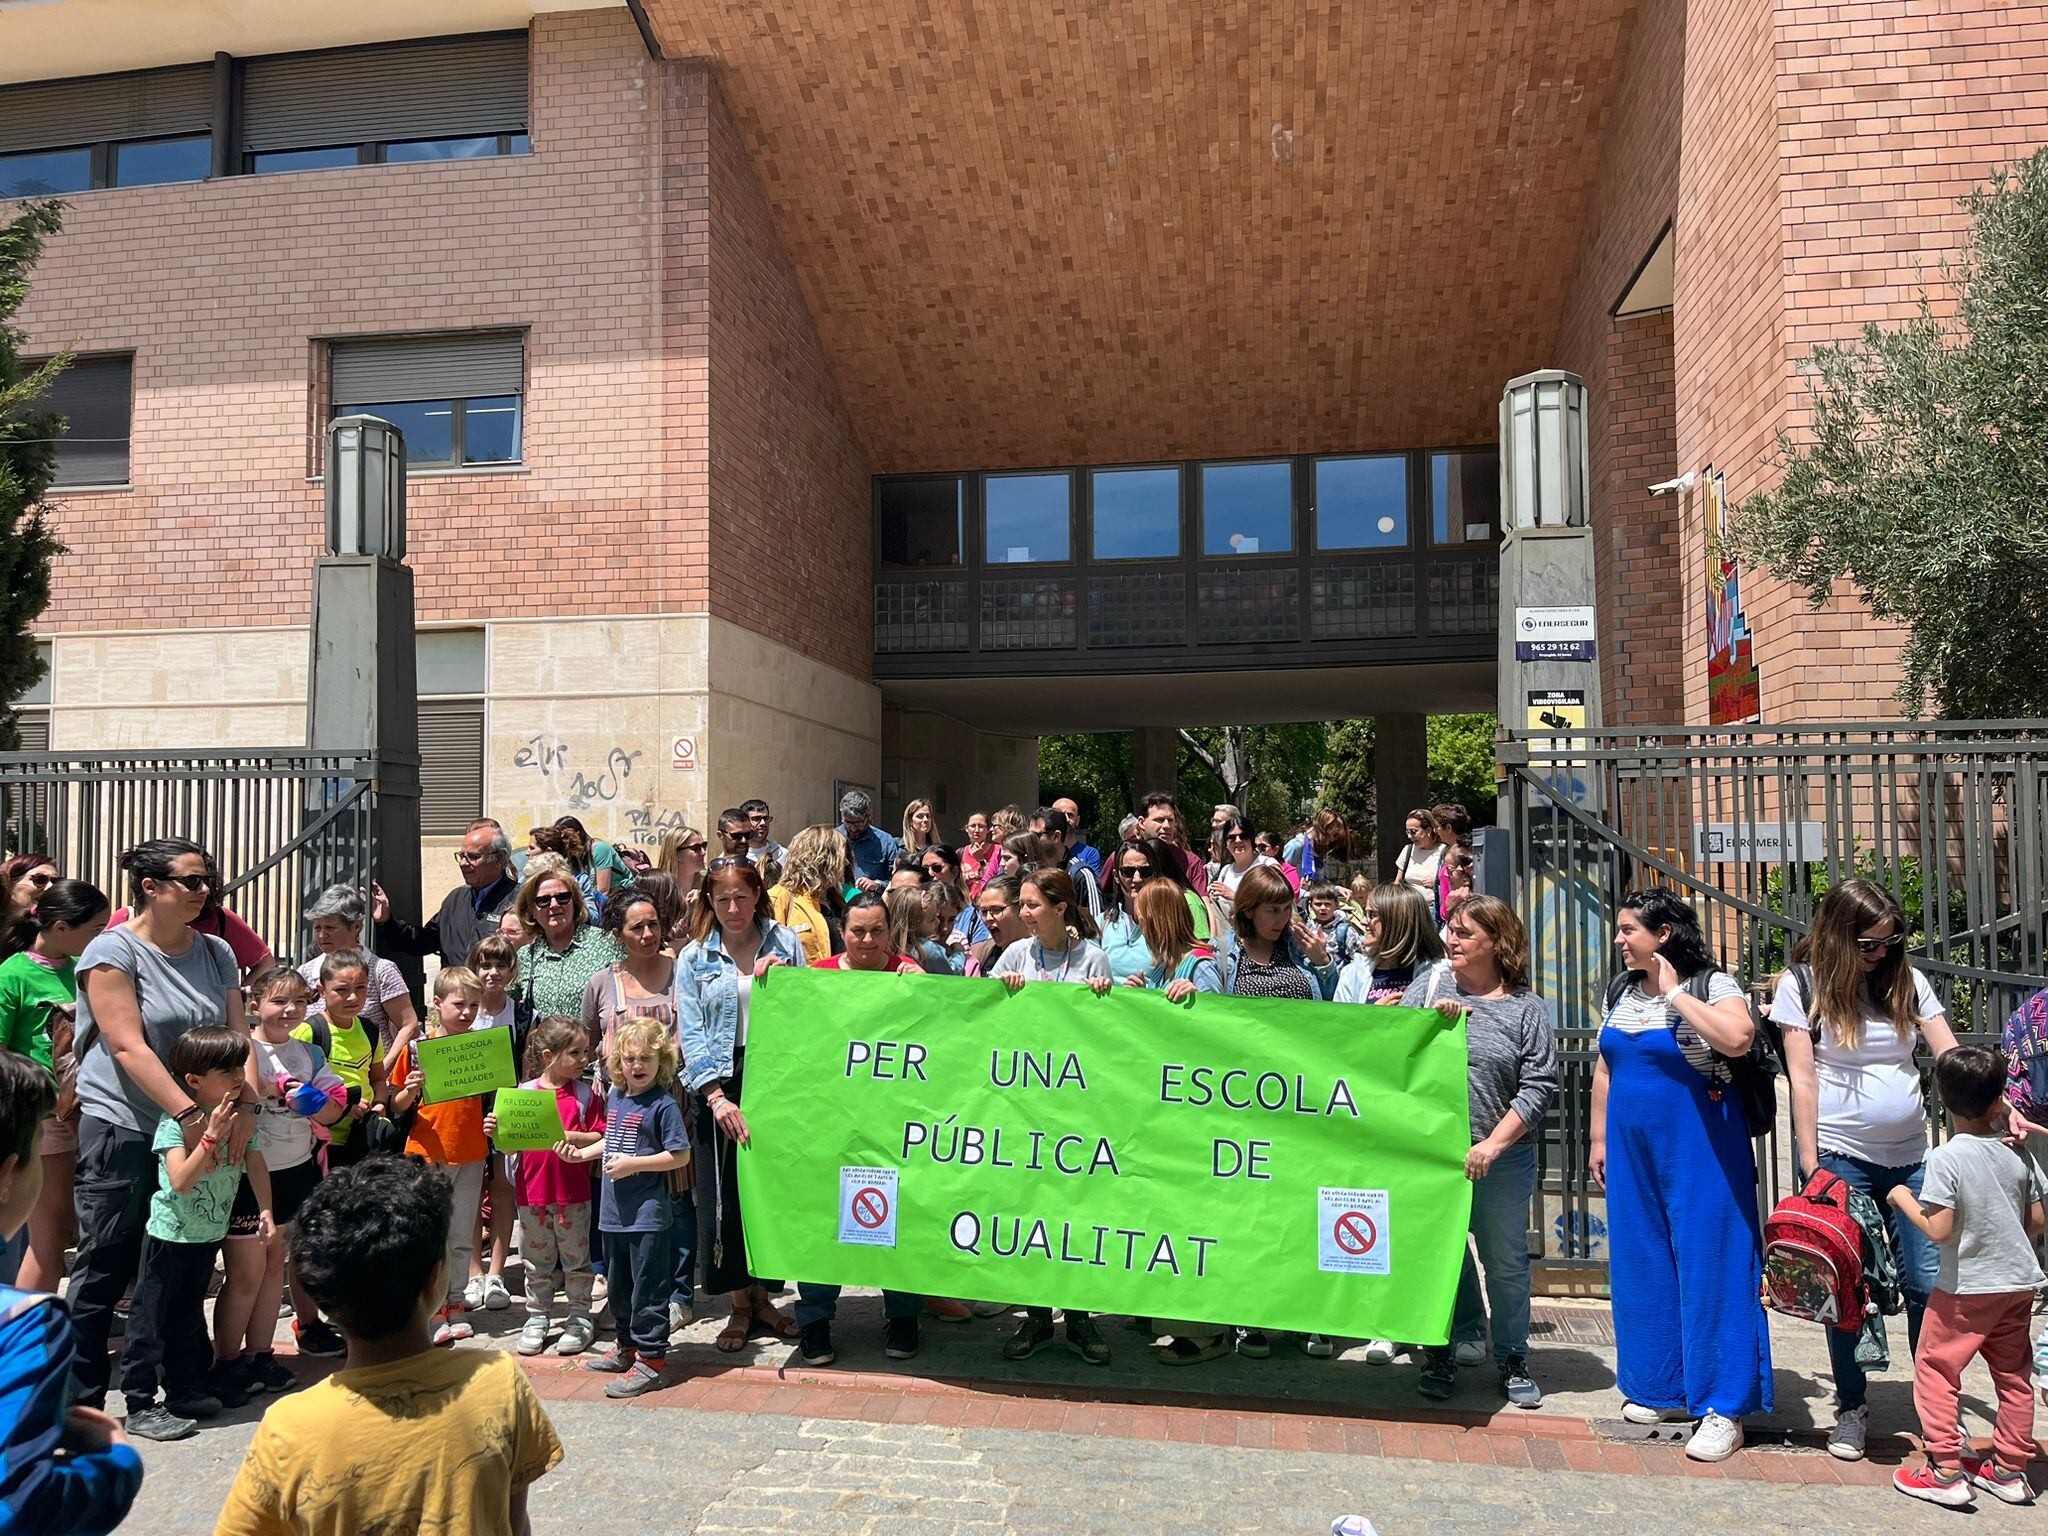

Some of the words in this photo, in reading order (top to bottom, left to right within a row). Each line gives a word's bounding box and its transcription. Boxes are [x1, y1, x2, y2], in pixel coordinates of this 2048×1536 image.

[1530, 643, 1546, 651] 965
[1547, 643, 1557, 651] 29
[1559, 643, 1569, 651] 12
[1570, 643, 1580, 651] 62
[436, 1047, 452, 1055] PER
[449, 1067, 463, 1076] NO
[470, 1063, 486, 1071] LES
[444, 1072, 494, 1088] RETALLADES
[845, 1040, 928, 1081] PER
[990, 1048, 1088, 1091] UNA
[1160, 1063, 1360, 1118] ESCOLA
[902, 1113, 1120, 1176] PÚBLICA
[1212, 1138, 1271, 1180] DE
[950, 1210, 1218, 1277] QUALITAT
